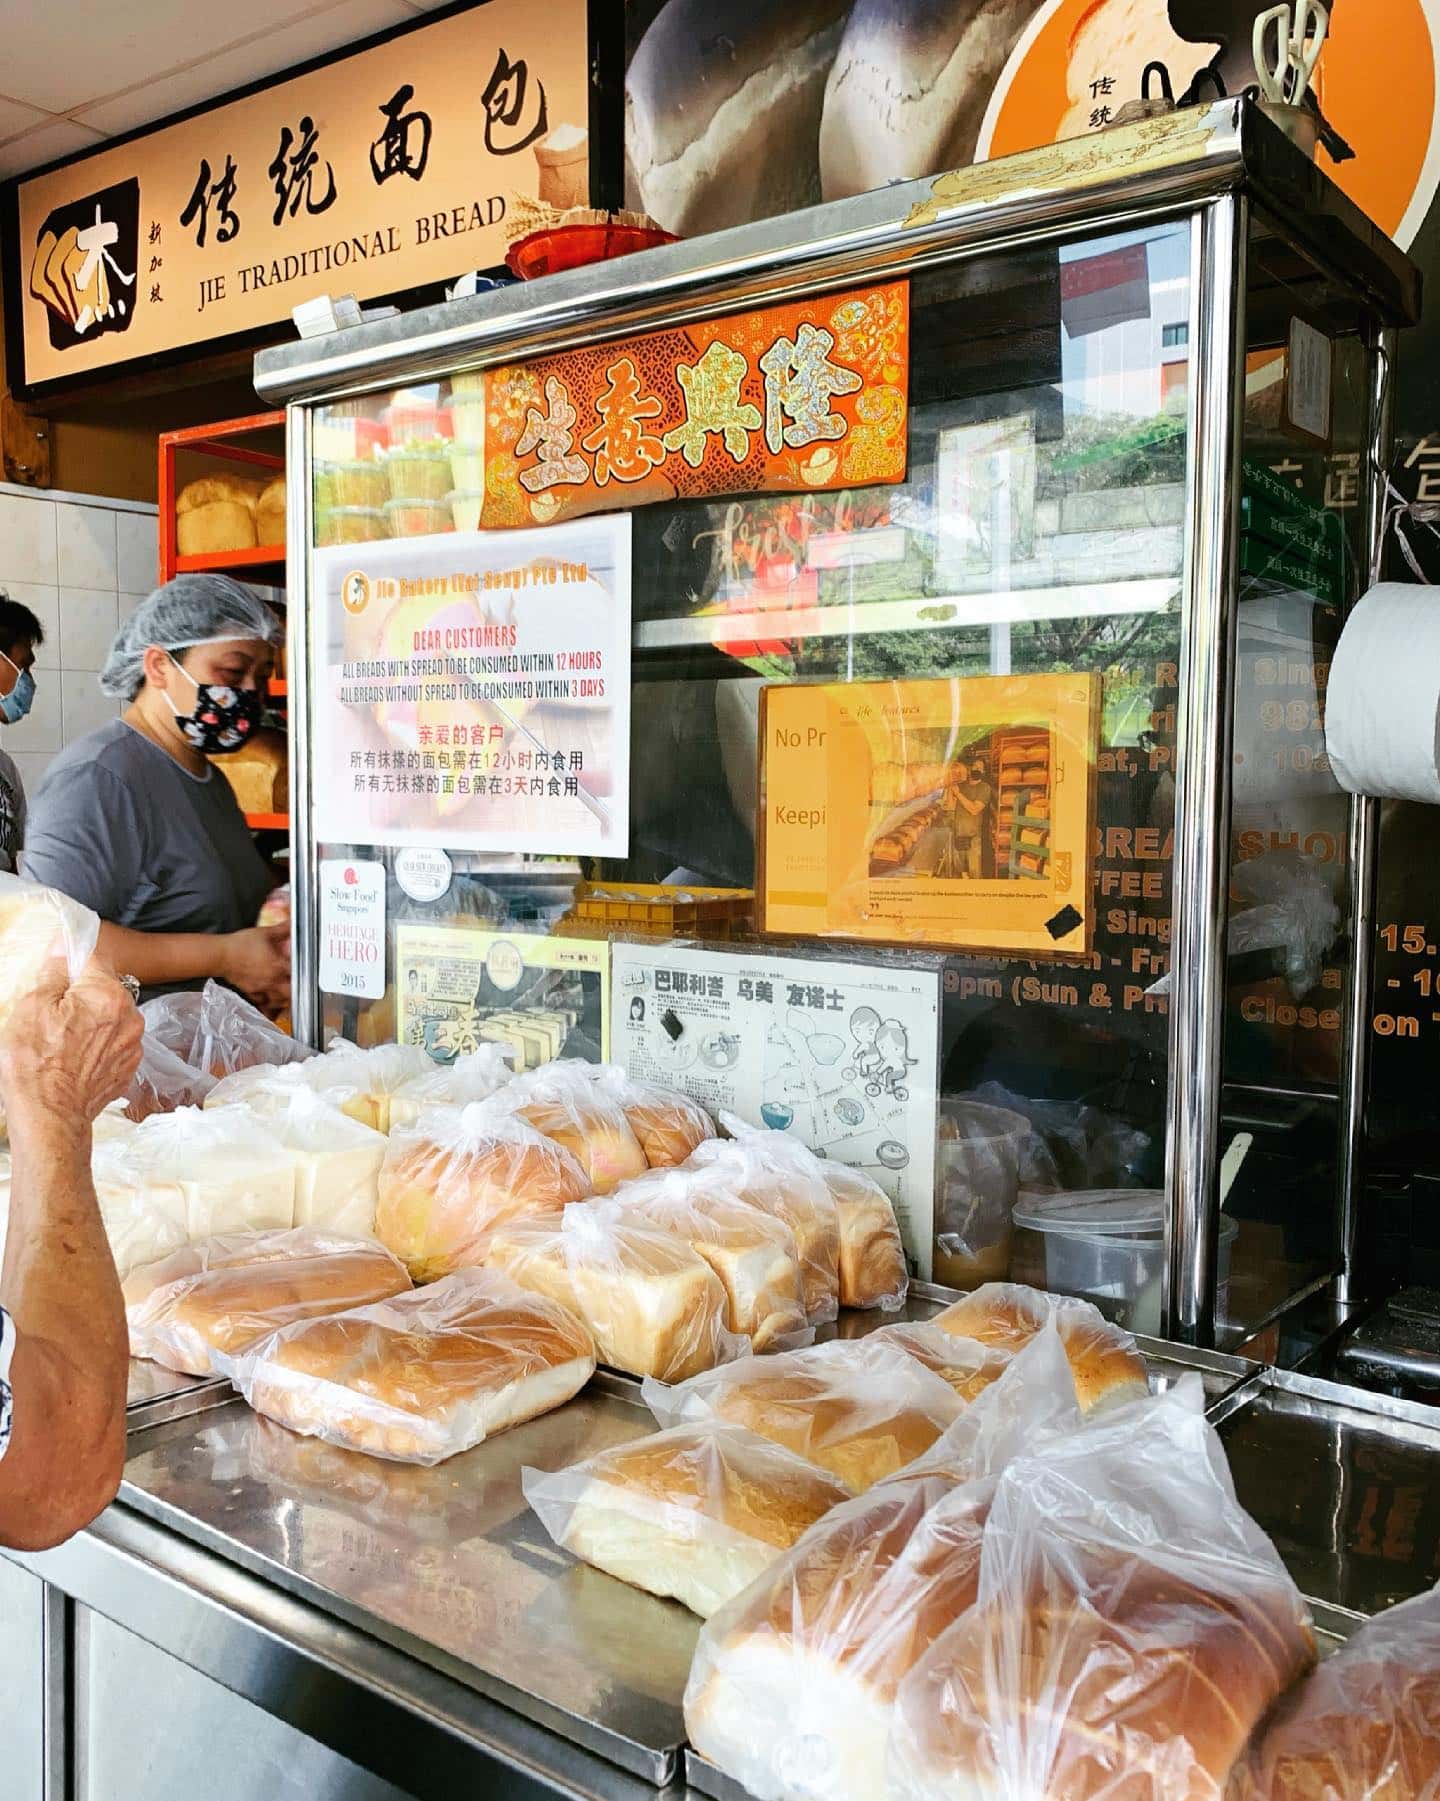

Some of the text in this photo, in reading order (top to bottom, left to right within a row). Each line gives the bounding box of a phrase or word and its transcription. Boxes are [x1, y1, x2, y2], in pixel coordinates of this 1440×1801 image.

[180, 48, 549, 248] 传统面包
[198, 195, 506, 312] JIE TRADITIONAL BREAD
[414, 625, 517, 651] DEAR CUSTOMERS
[342, 651, 602, 679] ALL BREADS WITH SPREAD TO BE CONSUMED WITHIN 12 HOURS
[341, 678, 605, 703] ALL BREADS WITHOUT SPREAD TO BE CONSUMED WITHIN 3 DAYS
[418, 723, 504, 745] 亲爱的客户
[775, 727, 827, 748] No Pr
[775, 804, 826, 830] Keepi
[1238, 830, 1346, 867] SHO
[330, 887, 376, 904] Slow Food
[328, 922, 377, 942] HERITAGE
[329, 938, 378, 964] HERO
[341, 972, 366, 990] 2015
[736, 978, 774, 1004] 乌美
[786, 983, 845, 1012] 友诺士
[944, 969, 1002, 1000] 9pm
[1011, 975, 1078, 1007] (Sun
[1089, 983, 1113, 1008] &
[1373, 1012, 1420, 1038] on
